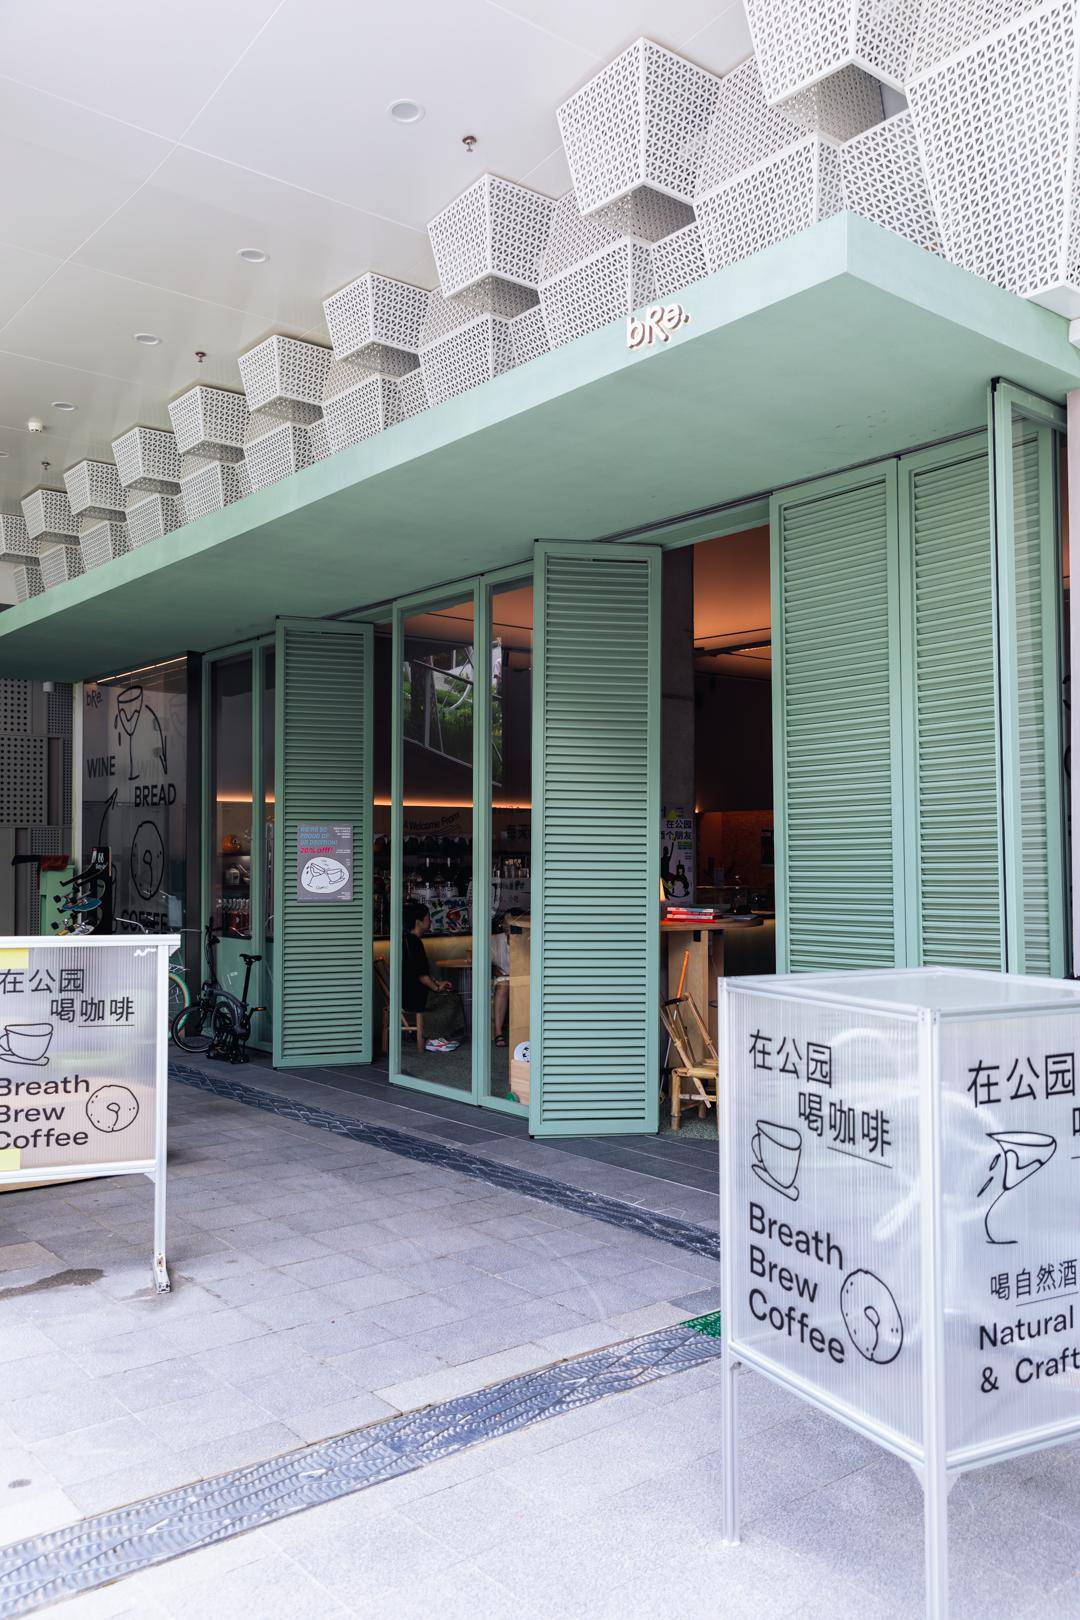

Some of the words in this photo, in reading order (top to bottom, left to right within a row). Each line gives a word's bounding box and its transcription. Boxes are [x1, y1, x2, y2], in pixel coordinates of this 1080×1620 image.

[86, 755, 116, 779] WINE
[134, 783, 176, 807] BREAD
[666, 819, 692, 830] 在公园
[0, 968, 85, 995] 在公园
[50, 996, 135, 1023] 喝咖啡
[748, 1028, 833, 1089] 在公园
[966, 1052, 1076, 1109] 在公园
[0, 1074, 90, 1097] Breath
[0, 1104, 65, 1123] Brew
[798, 1091, 892, 1158] 喝咖啡
[0, 1127, 89, 1150] Coffee
[749, 1201, 844, 1271] Breath
[749, 1244, 819, 1304] Brew
[990, 1258, 1079, 1302] 喝自然酒
[748, 1287, 845, 1364] Coffee
[979, 1304, 1075, 1352] Natural
[981, 1365, 1000, 1394] &
[1015, 1347, 1080, 1386] Craft
